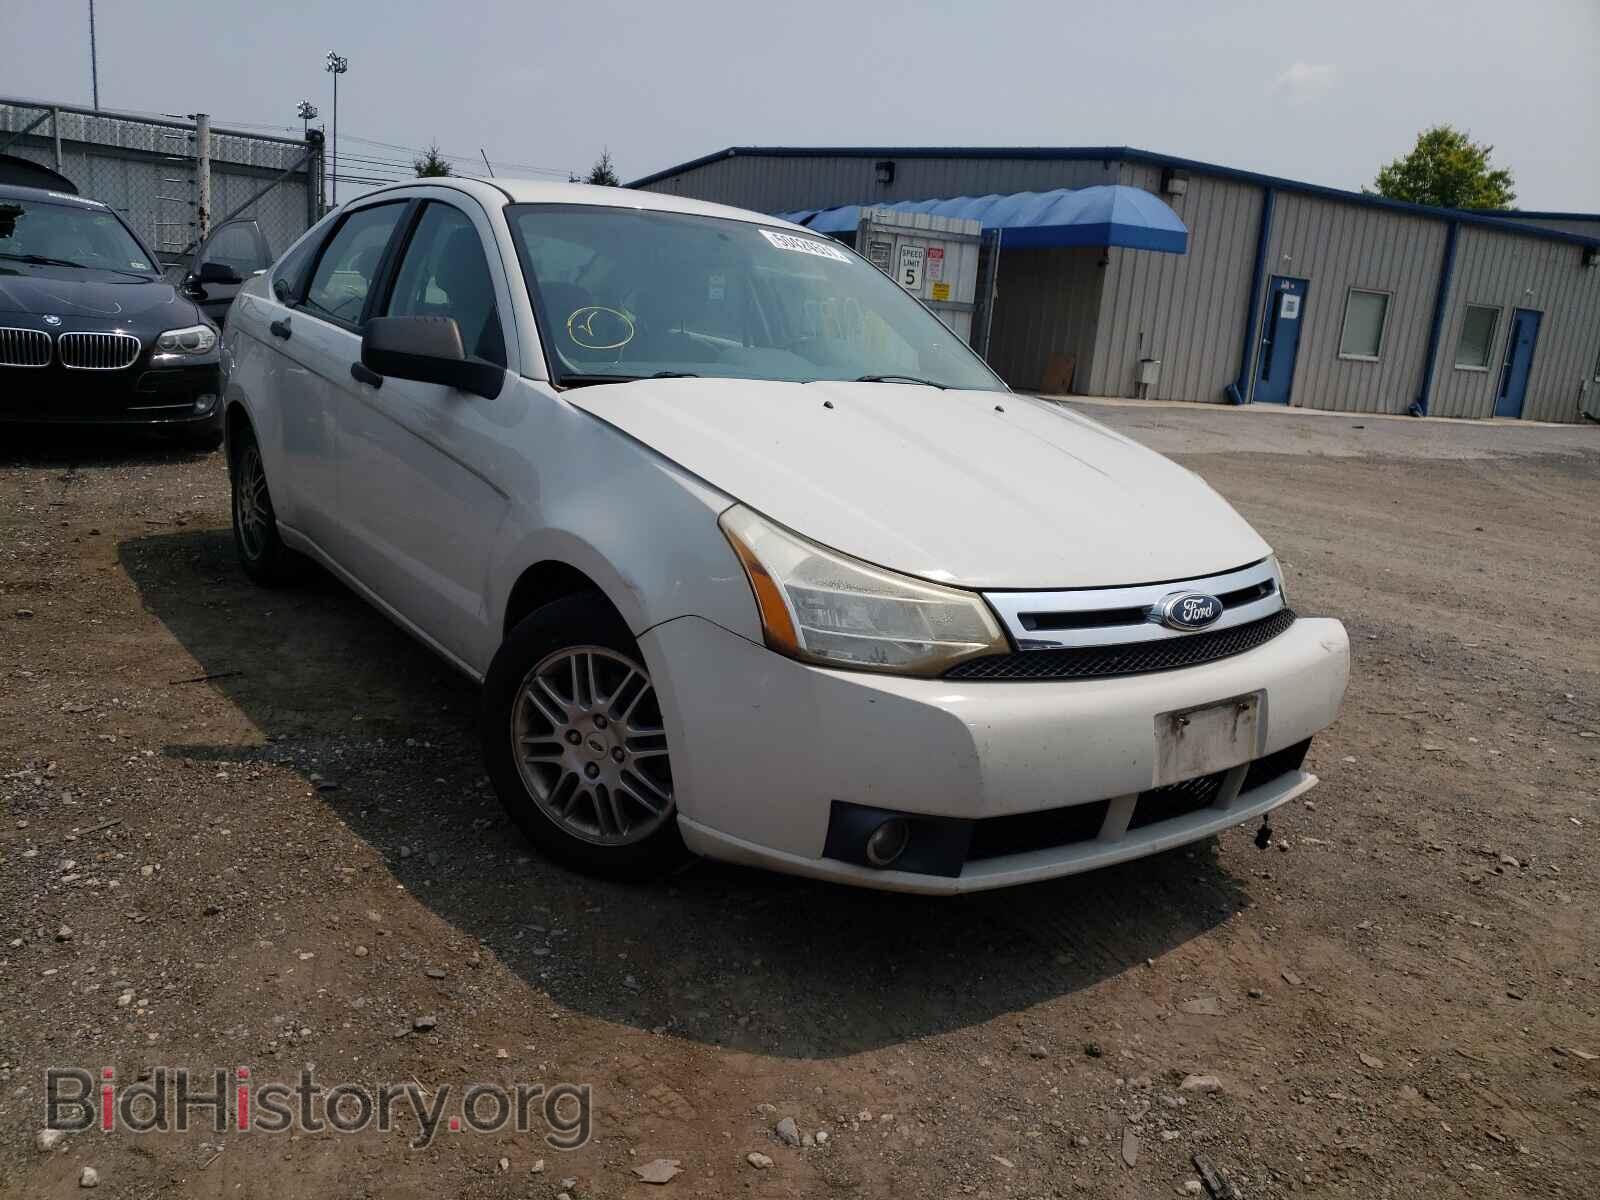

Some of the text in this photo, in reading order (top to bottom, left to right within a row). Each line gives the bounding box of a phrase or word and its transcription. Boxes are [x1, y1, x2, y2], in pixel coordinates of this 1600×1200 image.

[902, 248, 923, 258] SPEED
[903, 259, 920, 268] LIMIT
[905, 269, 915, 285] 5
[1183, 598, 1214, 621] Ford
